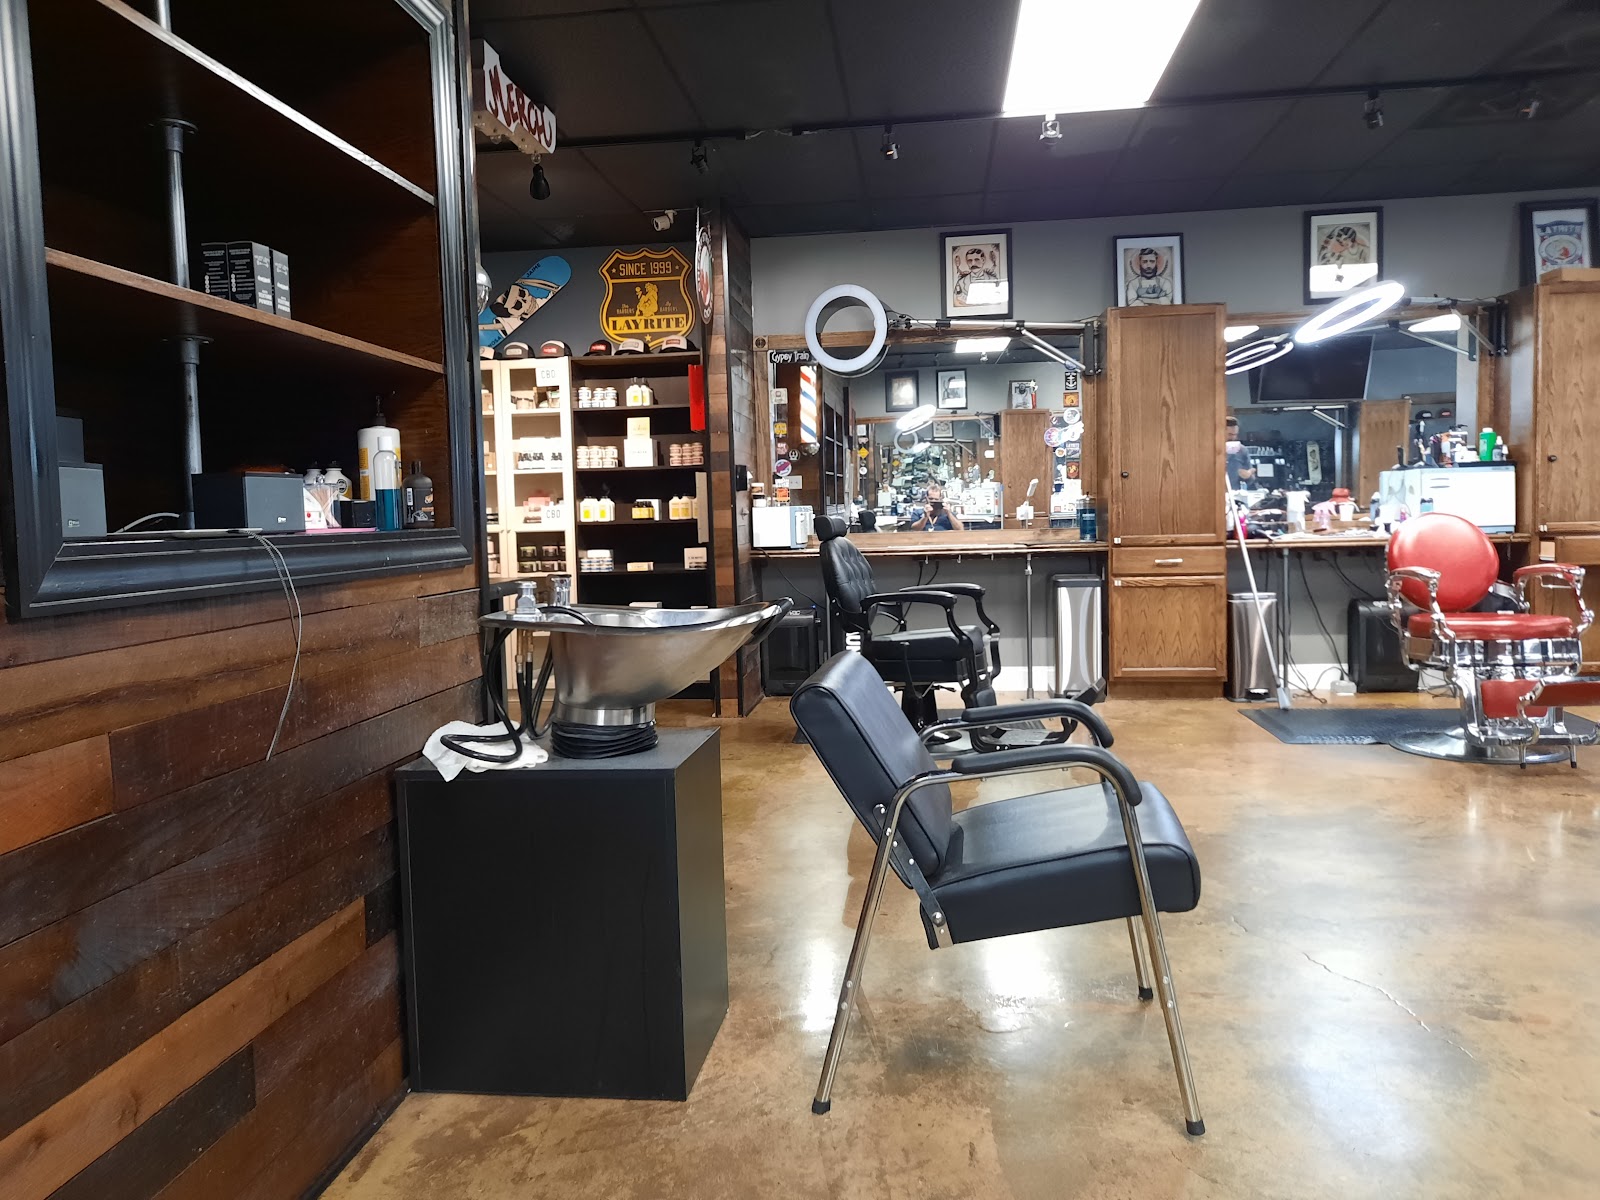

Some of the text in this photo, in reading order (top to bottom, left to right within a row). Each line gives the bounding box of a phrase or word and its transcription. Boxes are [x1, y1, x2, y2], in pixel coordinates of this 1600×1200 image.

[489, 65, 552, 147] MERCH
[526, 263, 541, 278] JAIME
[619, 261, 672, 276] SINCE 1999
[611, 317, 685, 331] LAYRITE
[771, 350, 810, 364] Gypsy Train
[541, 369, 556, 379] CBD
[546, 509, 560, 519] CBD
